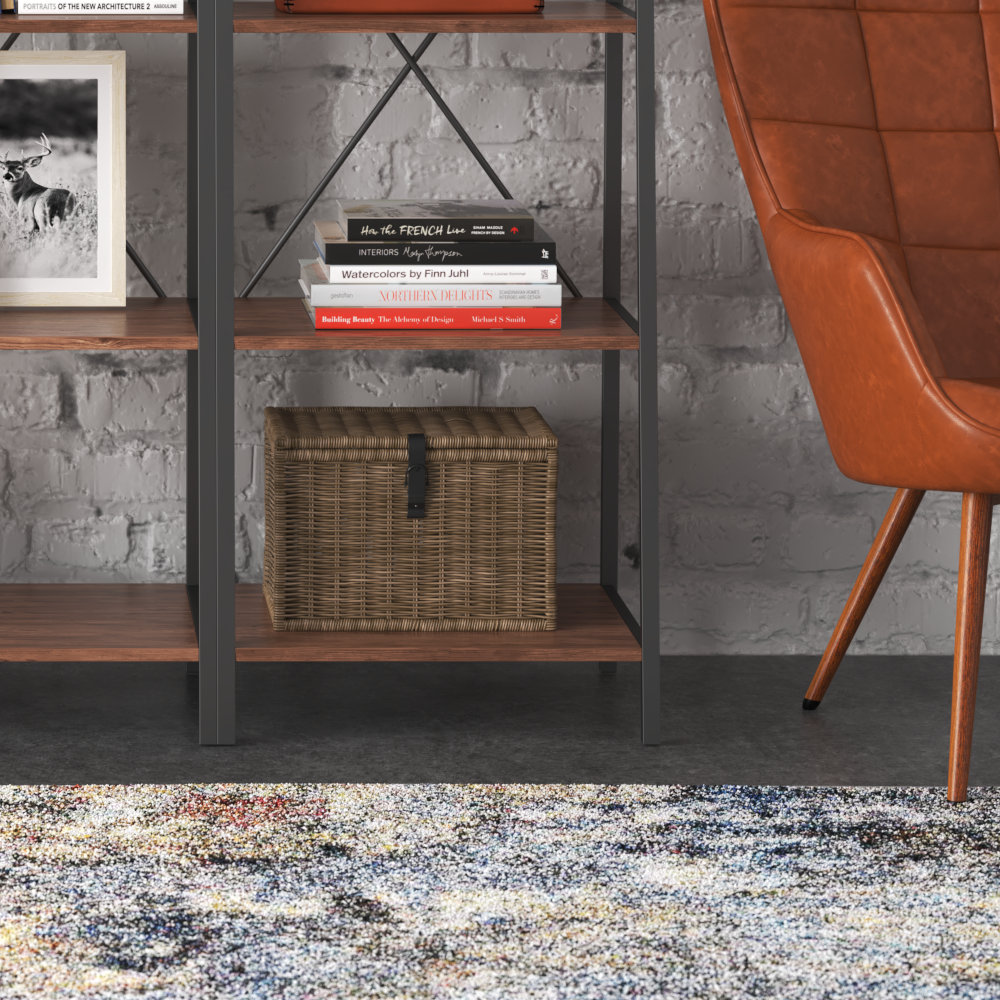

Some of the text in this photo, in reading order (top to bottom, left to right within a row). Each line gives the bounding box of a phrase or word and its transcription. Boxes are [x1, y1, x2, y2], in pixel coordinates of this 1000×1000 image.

[360, 224, 466, 236] How the FRENCH Live
[342, 269, 469, 280] Watercolors by Finn Juhl
[379, 289, 493, 301] NORTHERN DELIGHTS
[321, 316, 351, 324] Building
[352, 316, 375, 324] Beauty
[392, 315, 420, 324] Alchemy
[421, 315, 430, 323] of
[431, 316, 454, 325] Design
[471, 315, 496, 323] Michael
[505, 315, 526, 323] Smith
